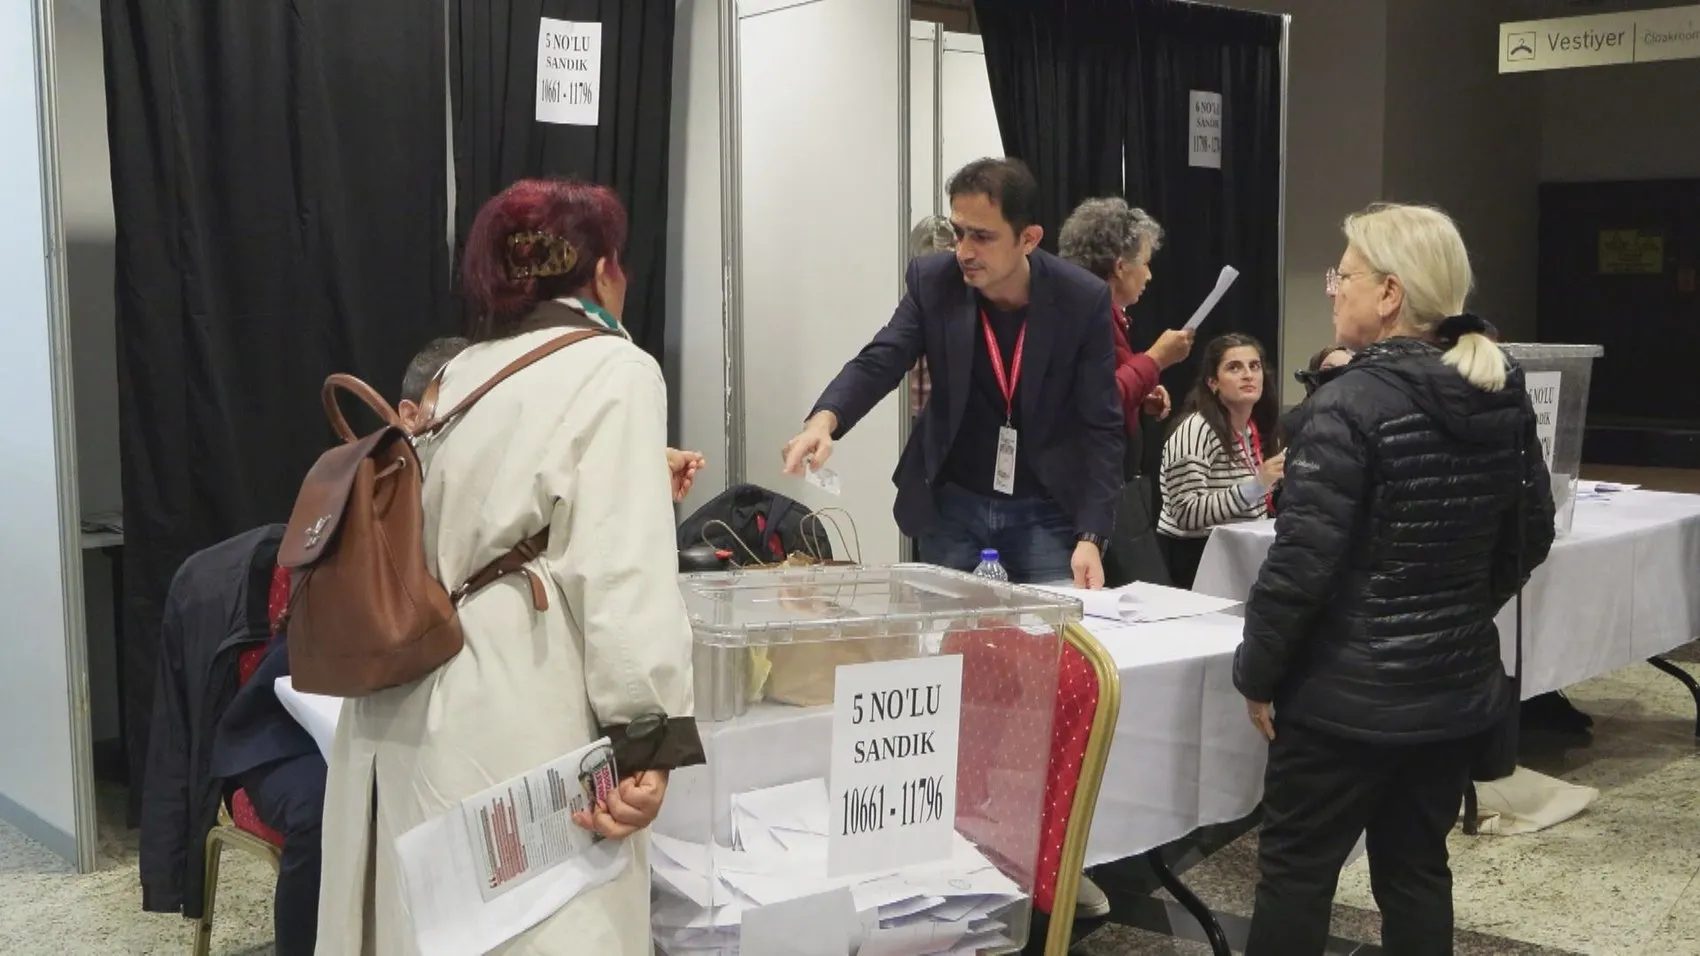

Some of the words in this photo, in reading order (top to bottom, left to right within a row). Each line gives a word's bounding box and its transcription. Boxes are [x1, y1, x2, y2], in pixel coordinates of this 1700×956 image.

[545, 32, 552, 48] 5
[553, 33, 590, 51] NO'LU
[1547, 29, 1626, 52] Vestiyer
[546, 56, 588, 71] SANDIK
[541, 79, 561, 103] 10661
[569, 81, 593, 105] 11796
[852, 693, 863, 725] 5
[869, 684, 941, 723] NO'LU
[854, 730, 935, 764] SANDIK
[842, 784, 885, 836] 10661
[901, 774, 944, 827] 11796
